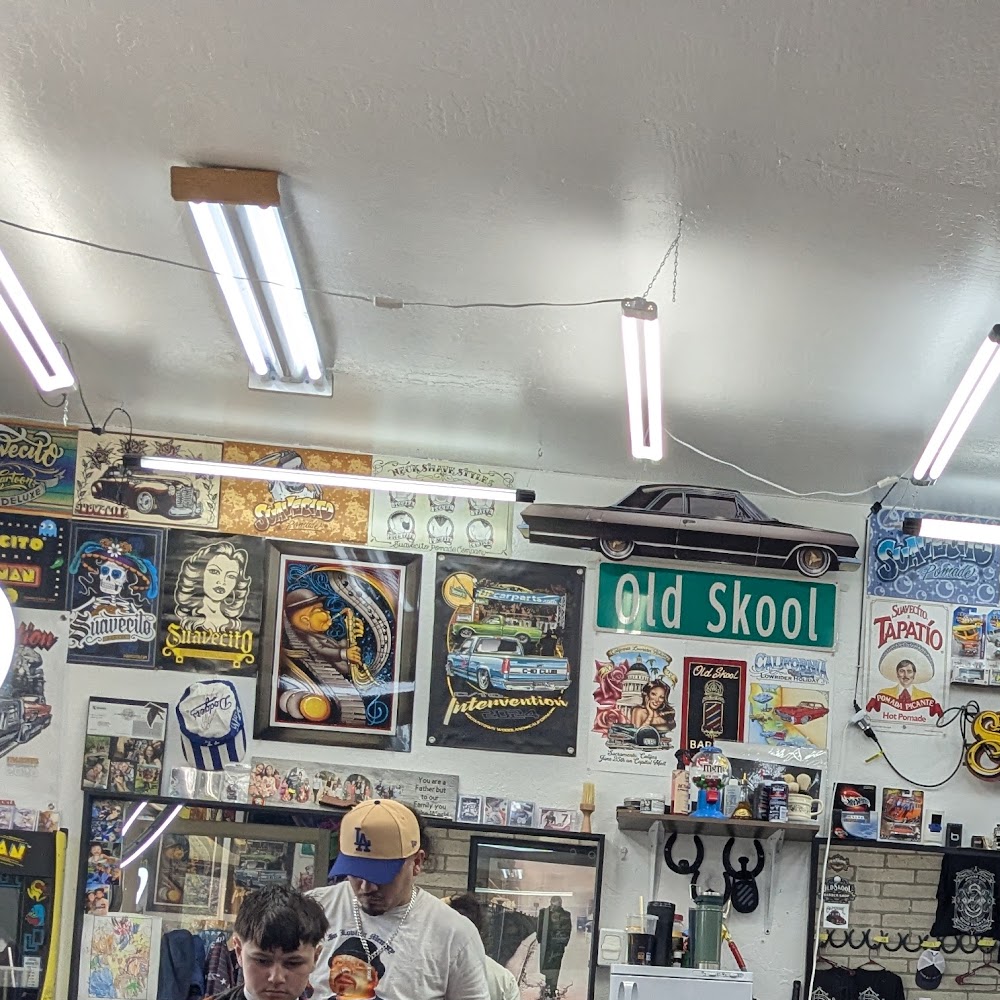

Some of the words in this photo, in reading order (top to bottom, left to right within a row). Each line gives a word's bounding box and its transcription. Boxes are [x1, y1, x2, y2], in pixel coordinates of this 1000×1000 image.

[389, 464, 420, 477] NECK
[421, 462, 456, 475] SHAVE
[1, 488, 42, 506] DELUXE
[615, 571, 683, 629] Old
[707, 580, 818, 643] Skool
[166, 622, 254, 654] Suavecito
[873, 616, 943, 651] TAPATÍO
[692, 665, 711, 677] Old
[712, 667, 740, 680] Skool
[443, 695, 569, 726] Intervention
[905, 699, 935, 711] PICANTE
[883, 712, 896, 720] Hot
[898, 713, 927, 723] Pomade
[418, 776, 431, 784] You
[414, 783, 435, 793] Father
[413, 800, 433, 810] Family
[434, 803, 447, 811] you
[354, 827, 371, 852] LA
